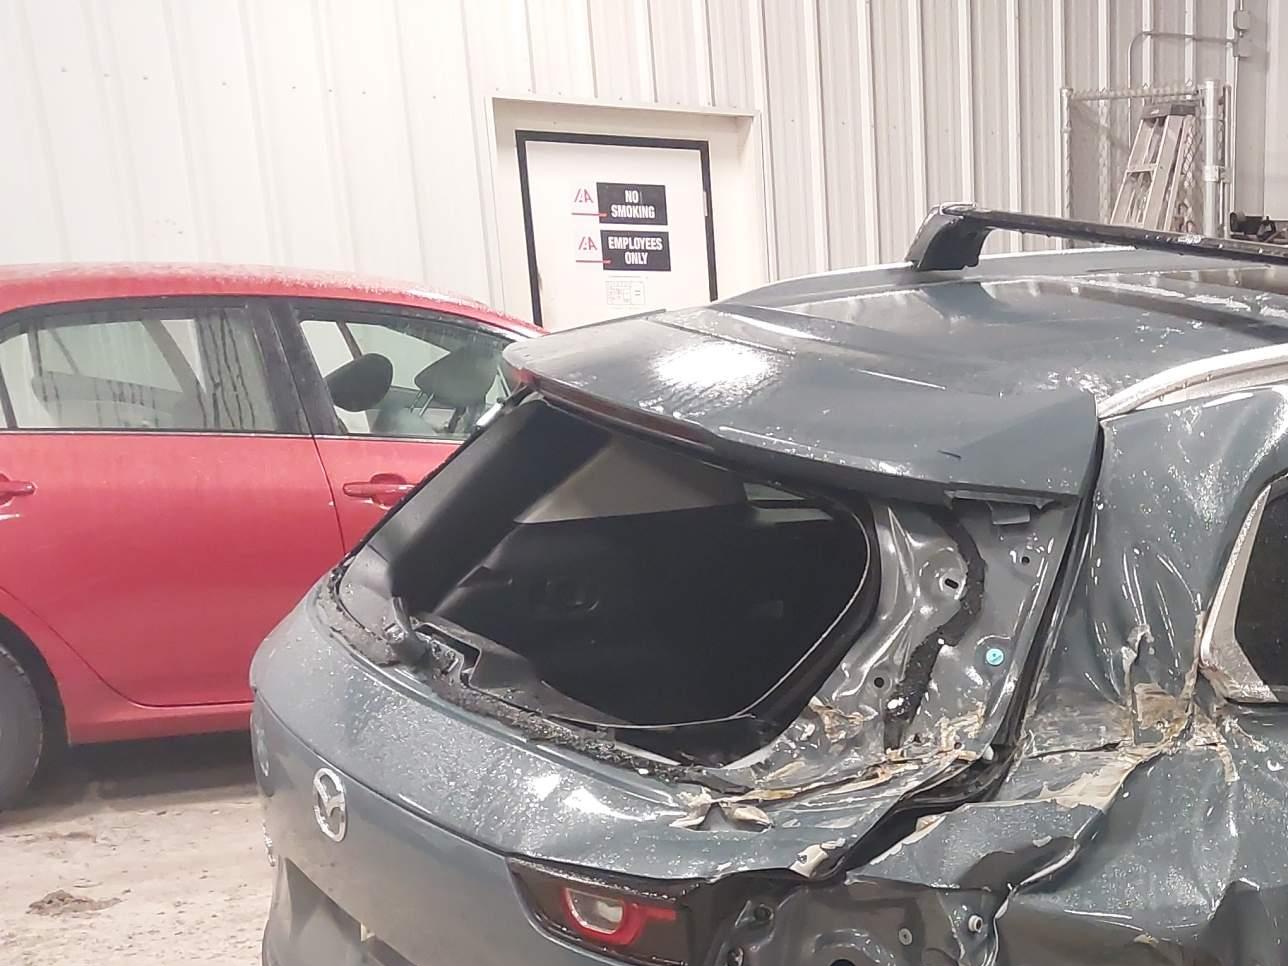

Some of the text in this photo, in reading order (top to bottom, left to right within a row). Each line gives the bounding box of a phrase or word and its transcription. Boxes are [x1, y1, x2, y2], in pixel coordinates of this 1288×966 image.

[624, 190, 640, 204] NO
[611, 204, 656, 219] SMOKING
[608, 236, 663, 251] EMPLOYEES
[624, 251, 649, 265] ONLY
